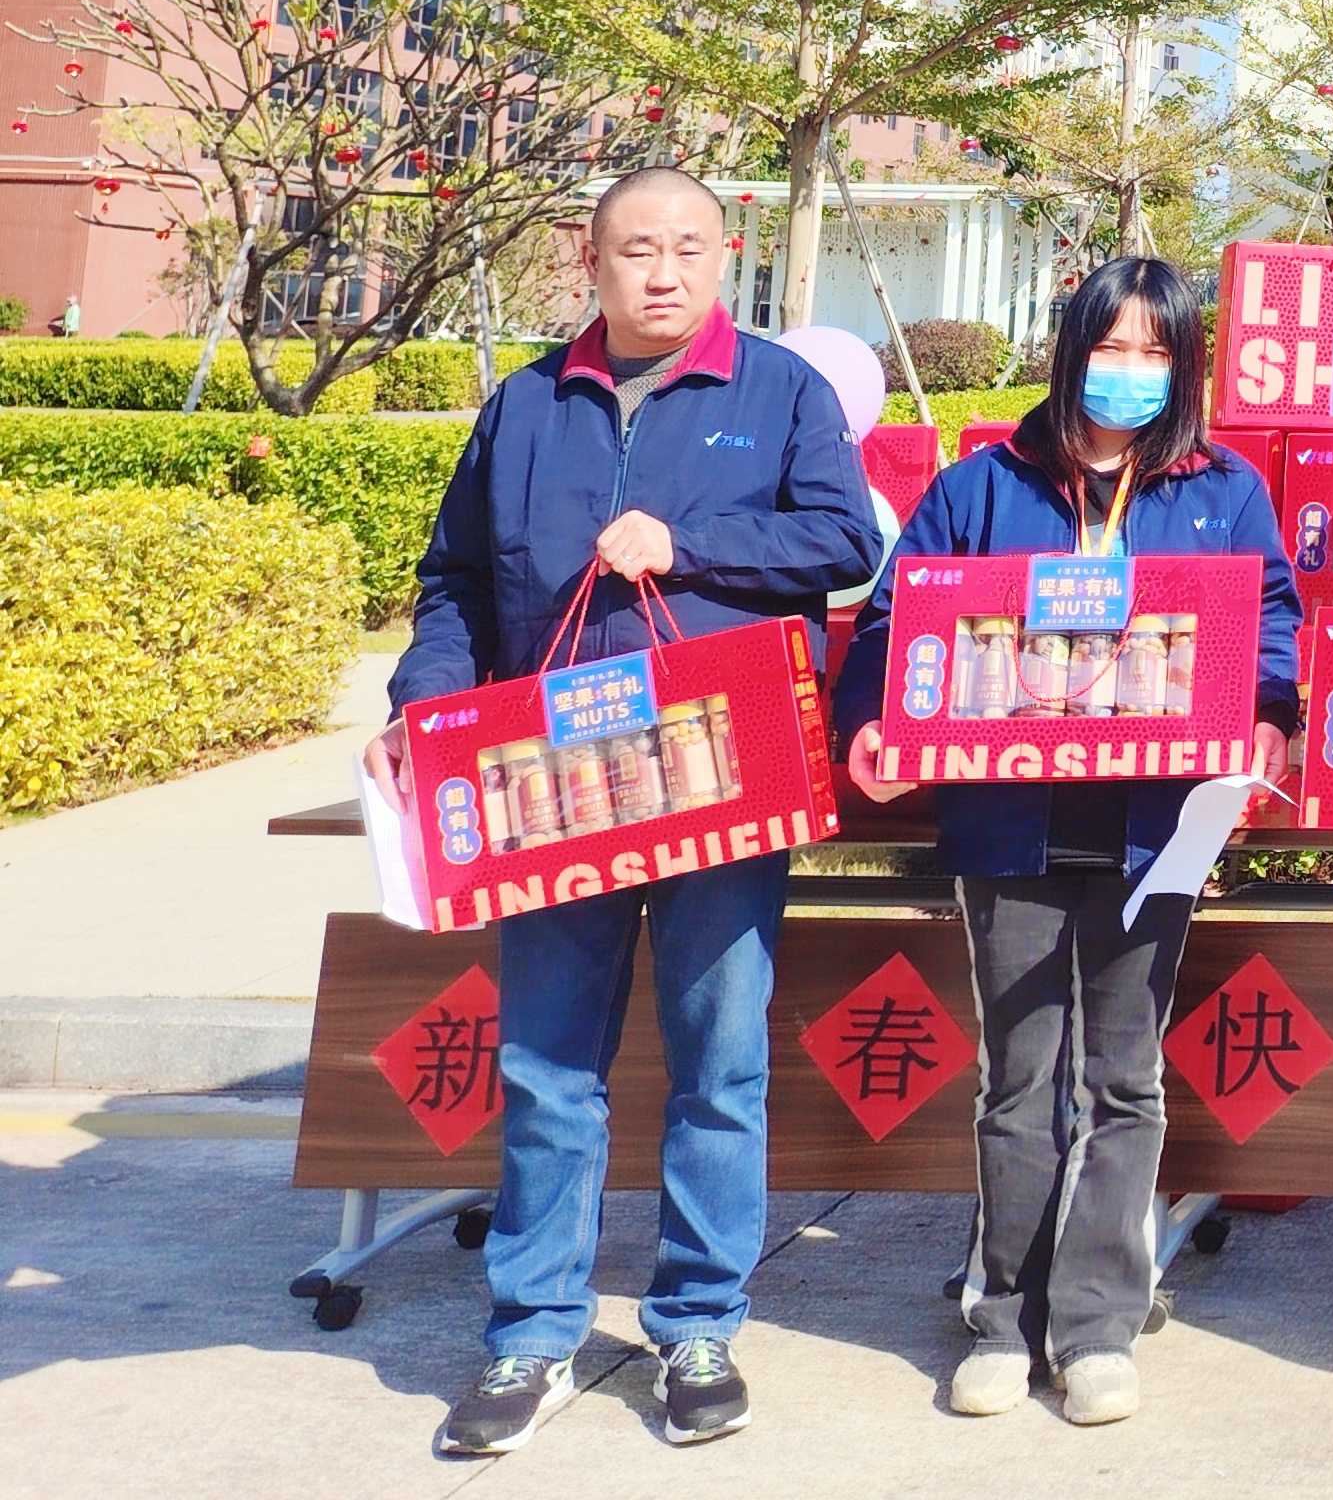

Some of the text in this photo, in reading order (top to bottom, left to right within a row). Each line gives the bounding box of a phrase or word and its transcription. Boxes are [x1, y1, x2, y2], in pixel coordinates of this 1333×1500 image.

[1051, 601, 1106, 616] NUTS
[572, 703, 630, 729] NUTS
[408, 1005, 500, 1113] 新
[835, 995, 942, 1101] 春
[1203, 990, 1303, 1100] 快
